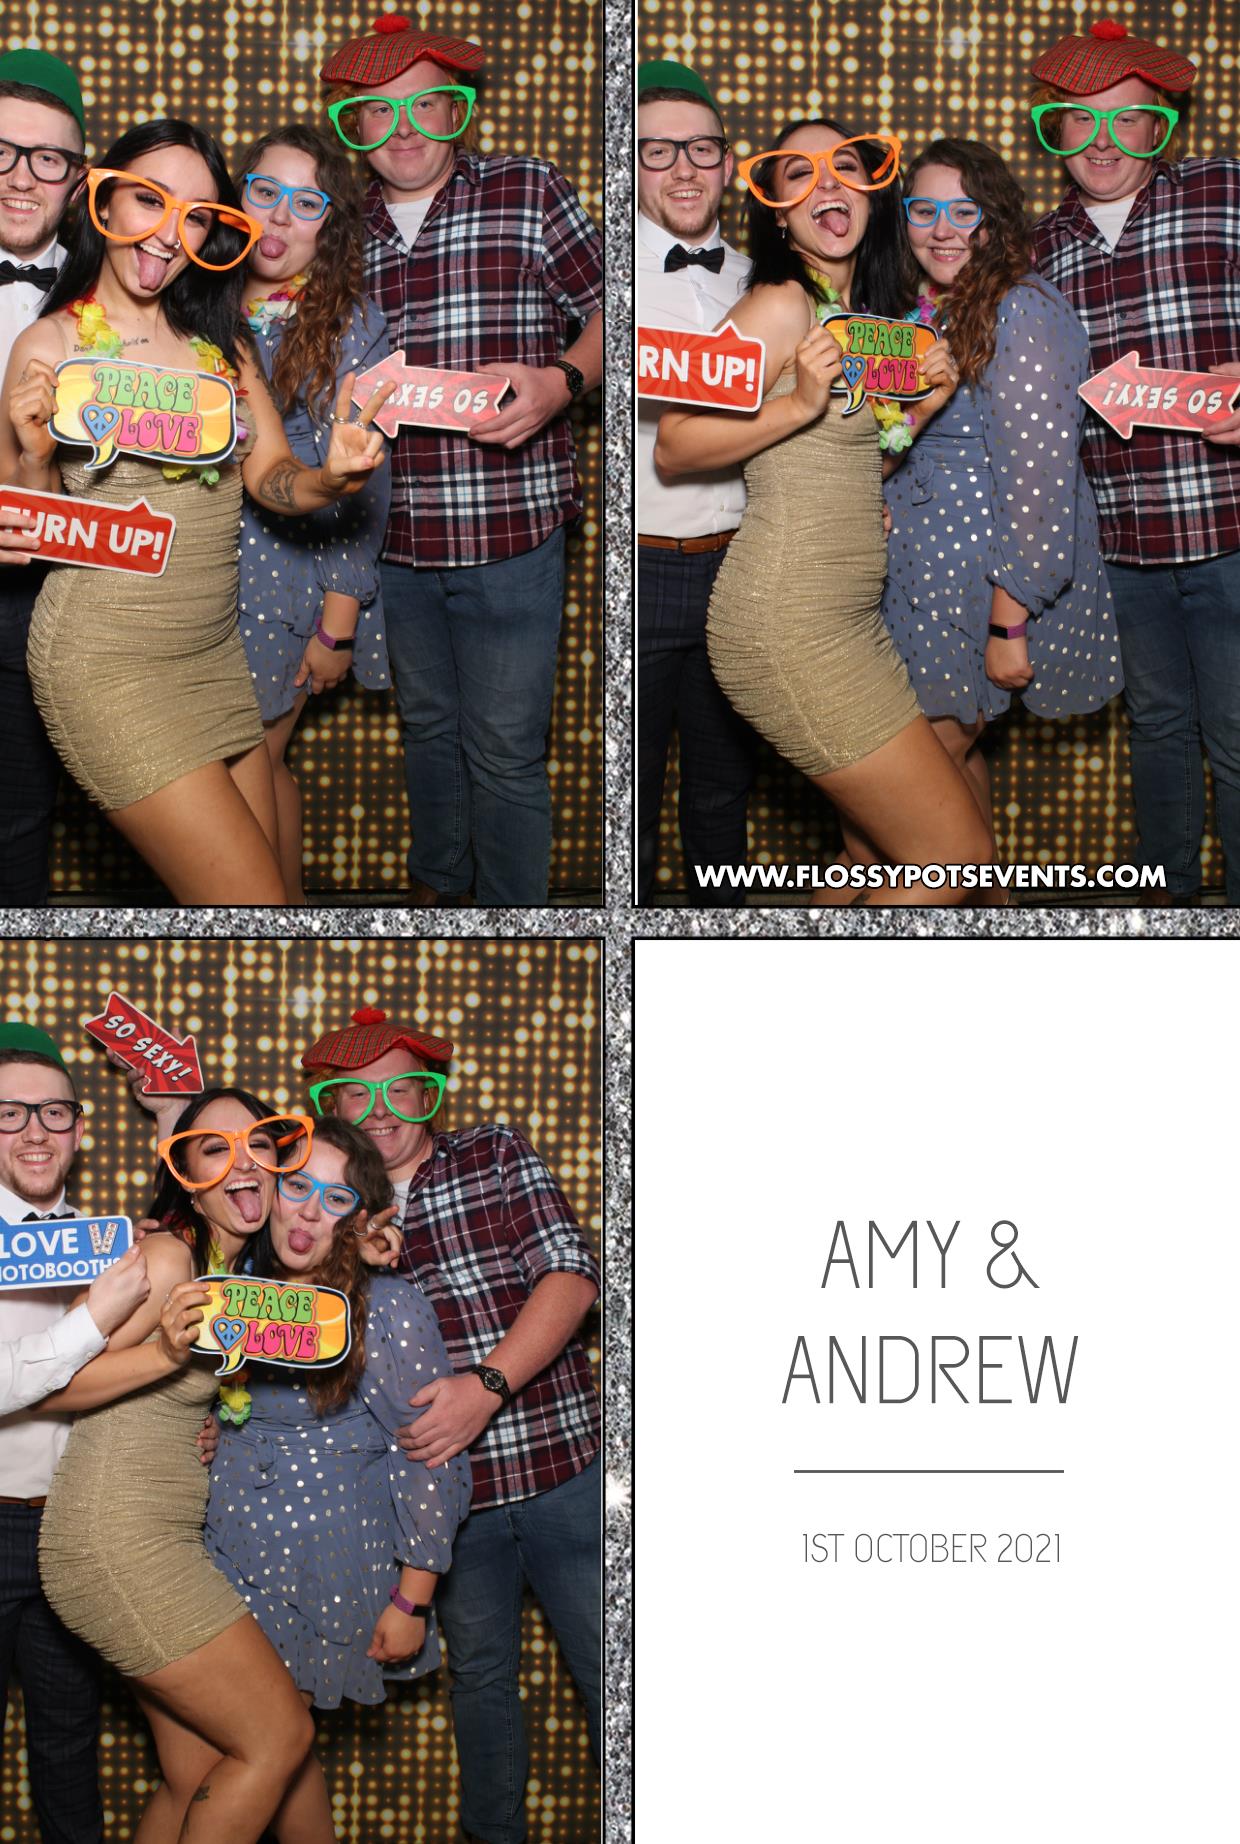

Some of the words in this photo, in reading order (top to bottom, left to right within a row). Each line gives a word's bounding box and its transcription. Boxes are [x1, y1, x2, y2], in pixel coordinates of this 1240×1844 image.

[848, 320, 915, 358] PEACE
[95, 366, 196, 413] PEACE
[701, 352, 756, 392] UP!
[865, 358, 917, 393] LOVE
[453, 388, 489, 414] SO
[1102, 381, 1178, 410] SEXY!
[1187, 389, 1223, 415] SO
[117, 409, 199, 452] LOVE
[108, 523, 166, 561] UP!
[104, 1015, 136, 1038] SO
[132, 1037, 193, 1082] SEXY!
[0, 1227, 79, 1259] LOVE
[0, 1257, 121, 1282] OTOBOOTH
[223, 1283, 315, 1324] PEACE
[245, 1321, 318, 1359] LOVE
